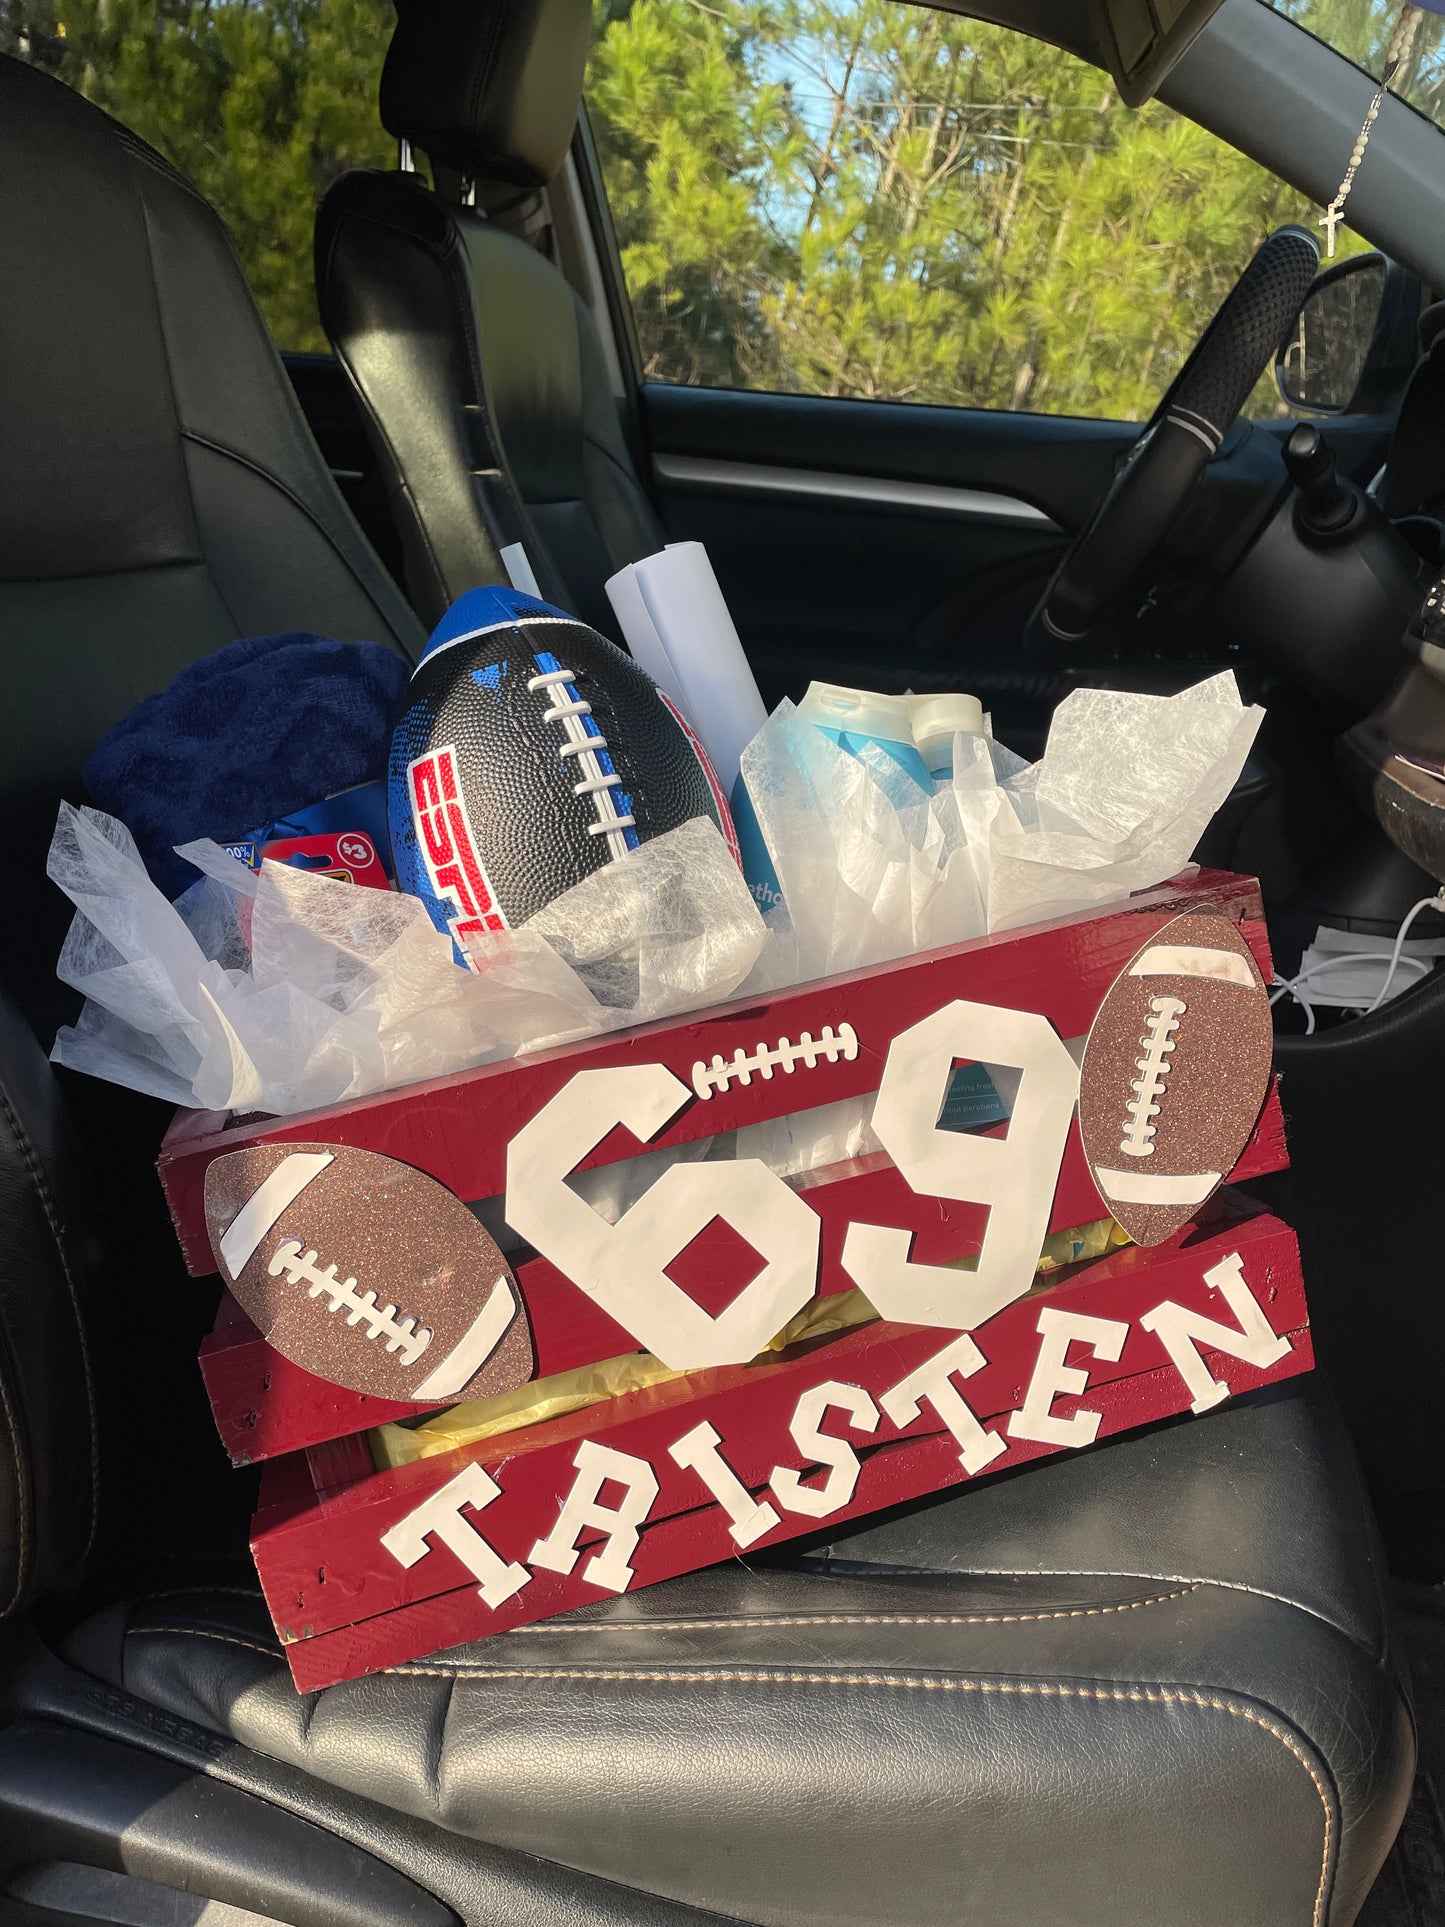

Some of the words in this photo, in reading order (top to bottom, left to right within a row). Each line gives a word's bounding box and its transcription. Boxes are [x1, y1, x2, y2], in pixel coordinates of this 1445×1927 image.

[342, 841, 368, 860] $3
[962, 1103, 1000, 1113] parabens
[380, 1252, 1294, 1610] TRISTEN
